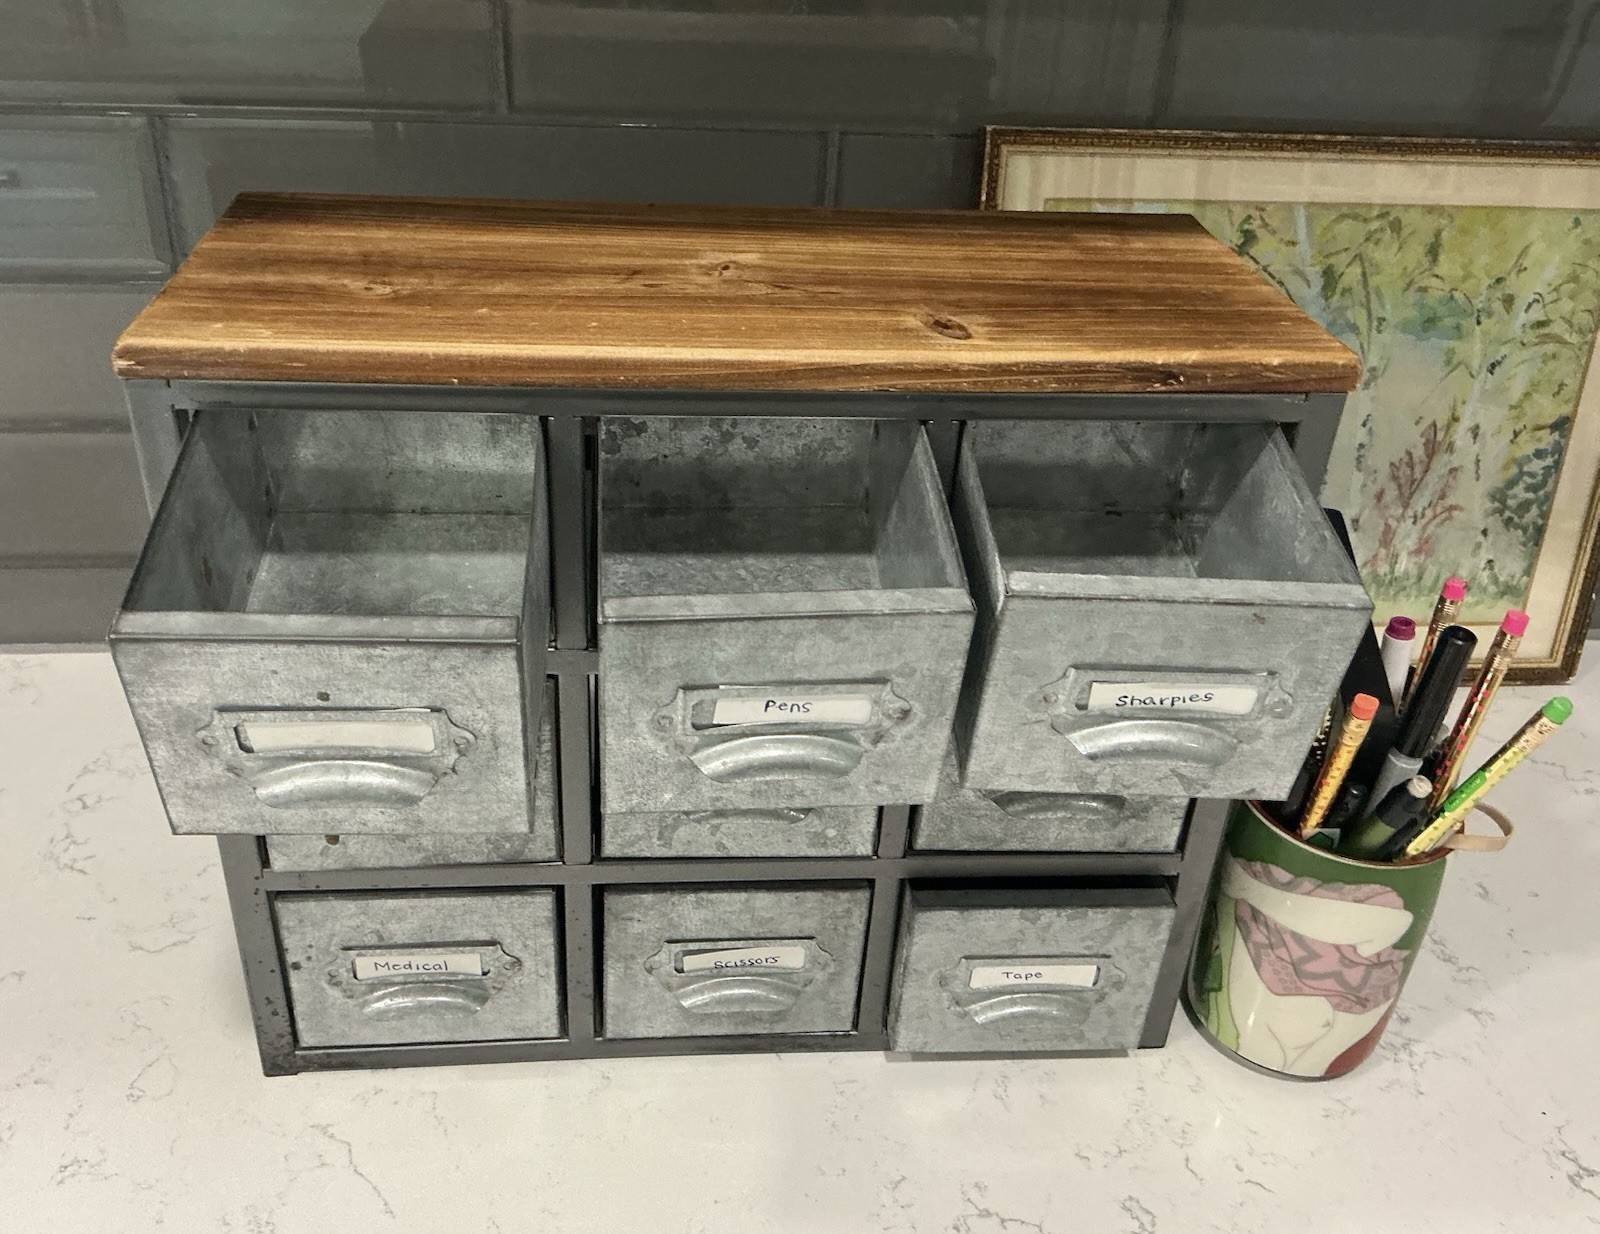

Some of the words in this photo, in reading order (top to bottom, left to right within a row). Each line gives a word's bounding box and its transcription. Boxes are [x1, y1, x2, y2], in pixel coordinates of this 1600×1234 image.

[763, 699, 813, 713] Pens
[1115, 692, 1214, 707] Sharpies
[373, 960, 449, 972] Medical
[1002, 970, 1043, 981] Tape
